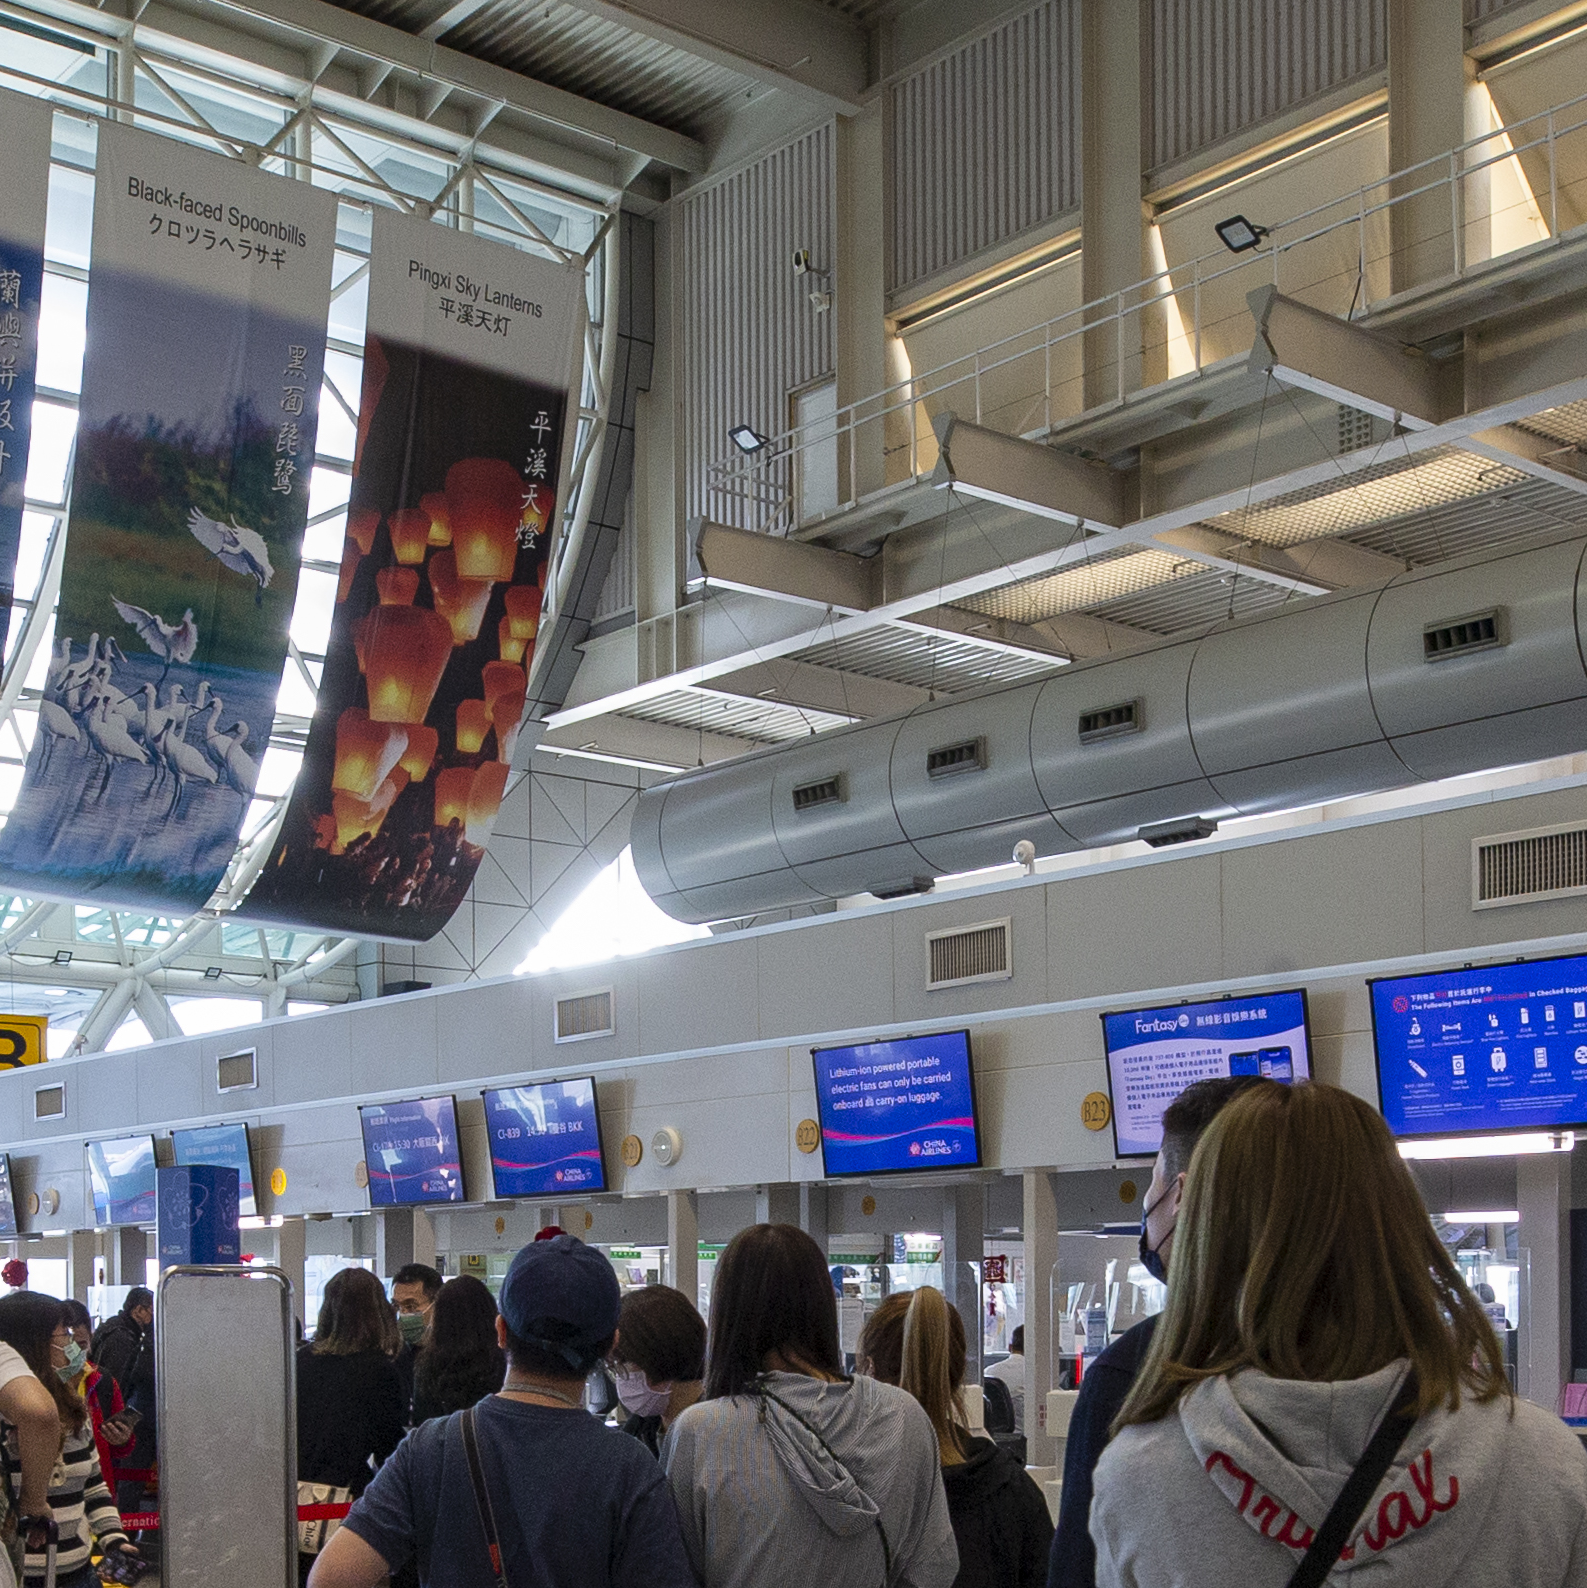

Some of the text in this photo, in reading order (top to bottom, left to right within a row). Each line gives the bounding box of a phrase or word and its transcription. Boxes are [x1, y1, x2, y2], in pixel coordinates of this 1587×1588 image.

[127, 175, 307, 248] Black-faced Spoonbills
[149, 213, 286, 270] クロツラヘラサギ
[408, 259, 543, 318] Pingxi Sky Lanterns
[439, 296, 511, 337] 平溪天灯
[271, 344, 308, 495] 黑面琵鷺
[514, 410, 552, 549] 平溪天燈
[1536, 987, 1565, 997] Checked
[1423, 1000, 1452, 1011] Following
[1135, 1017, 1178, 1035] Fantasy
[873, 1060, 906, 1076] powered
[907, 1056, 941, 1071] portable
[831, 1072, 952, 1095] electric fans can only be carried
[833, 1097, 864, 1111] onboard
[875, 1094, 908, 1108] carry-on
[1084, 1101, 1106, 1122] B23
[497, 1127, 521, 1140] CI-839
[568, 1120, 584, 1133] BKK
[921, 1146, 952, 1157] AIRLINES
[923, 1139, 947, 1149] CHINA
[563, 1174, 586, 1183] AIRLINES
[564, 1168, 582, 1176] CHINA
